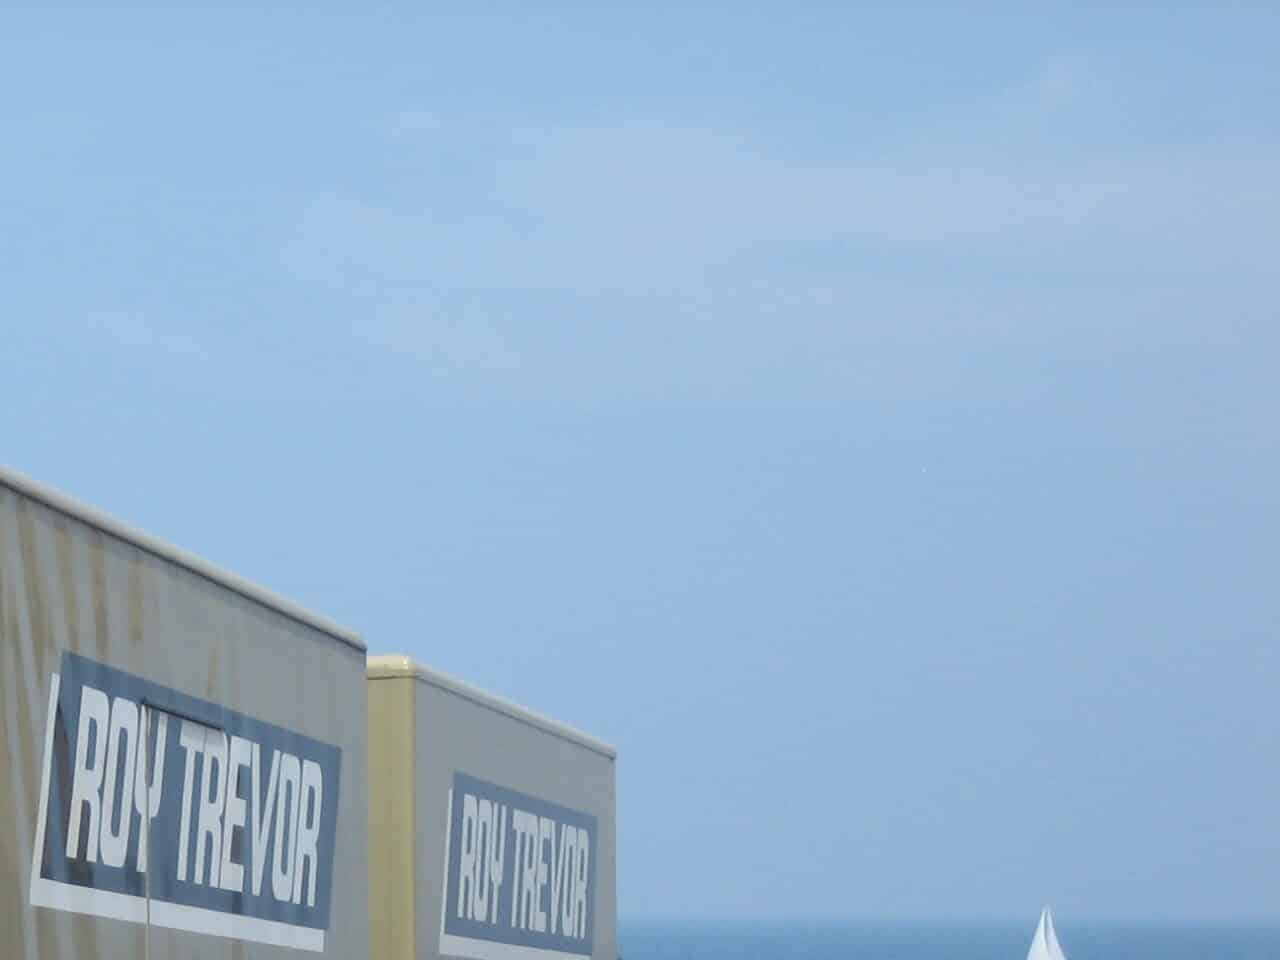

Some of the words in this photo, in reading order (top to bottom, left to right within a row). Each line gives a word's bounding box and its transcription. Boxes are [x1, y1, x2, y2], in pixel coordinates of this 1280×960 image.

[65, 685, 165, 873] ROY
[176, 726, 324, 907] TREVOR
[456, 793, 505, 925] ROY
[511, 812, 590, 941] TREVOR
